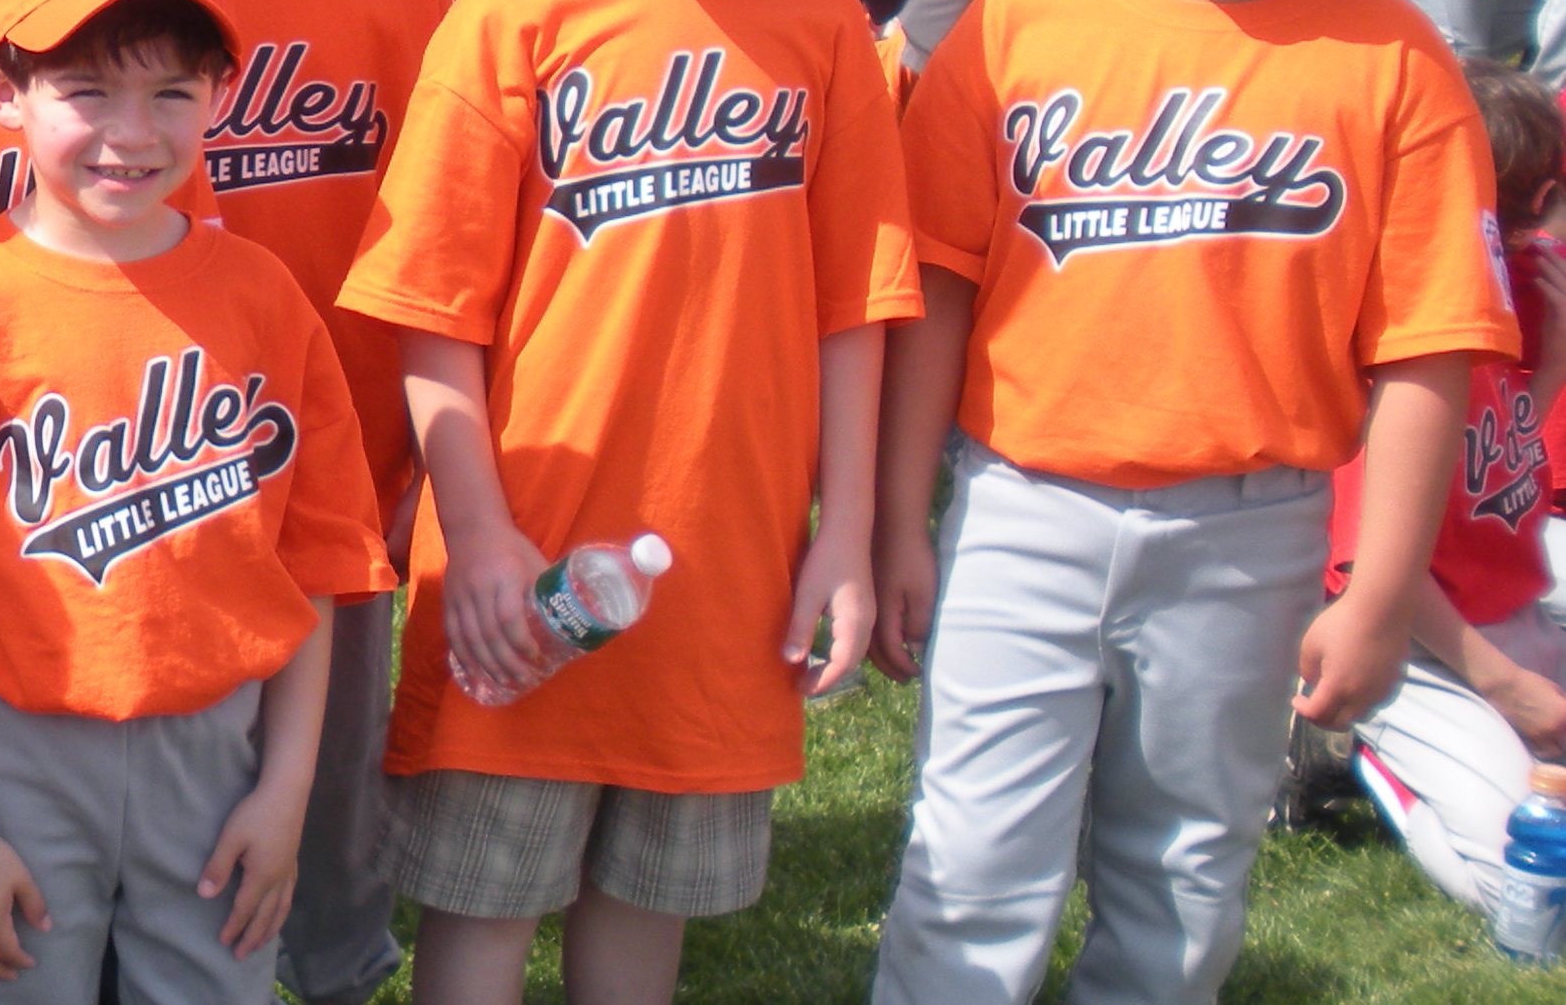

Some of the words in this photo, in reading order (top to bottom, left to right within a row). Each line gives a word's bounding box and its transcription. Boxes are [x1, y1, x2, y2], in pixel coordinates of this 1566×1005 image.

[536, 48, 808, 181] Valley
[241, 147, 321, 179] LEAGUE
[1005, 88, 1346, 201] Valley
[575, 175, 655, 218] LITTLE
[665, 162, 751, 199] LEAGUE
[1050, 207, 1128, 241] LITTLE
[1138, 202, 1229, 235] LEAGUE
[76, 499, 156, 559] LITTLE
[160, 460, 253, 522] LEAGUE
[549, 592, 589, 639] Spring
